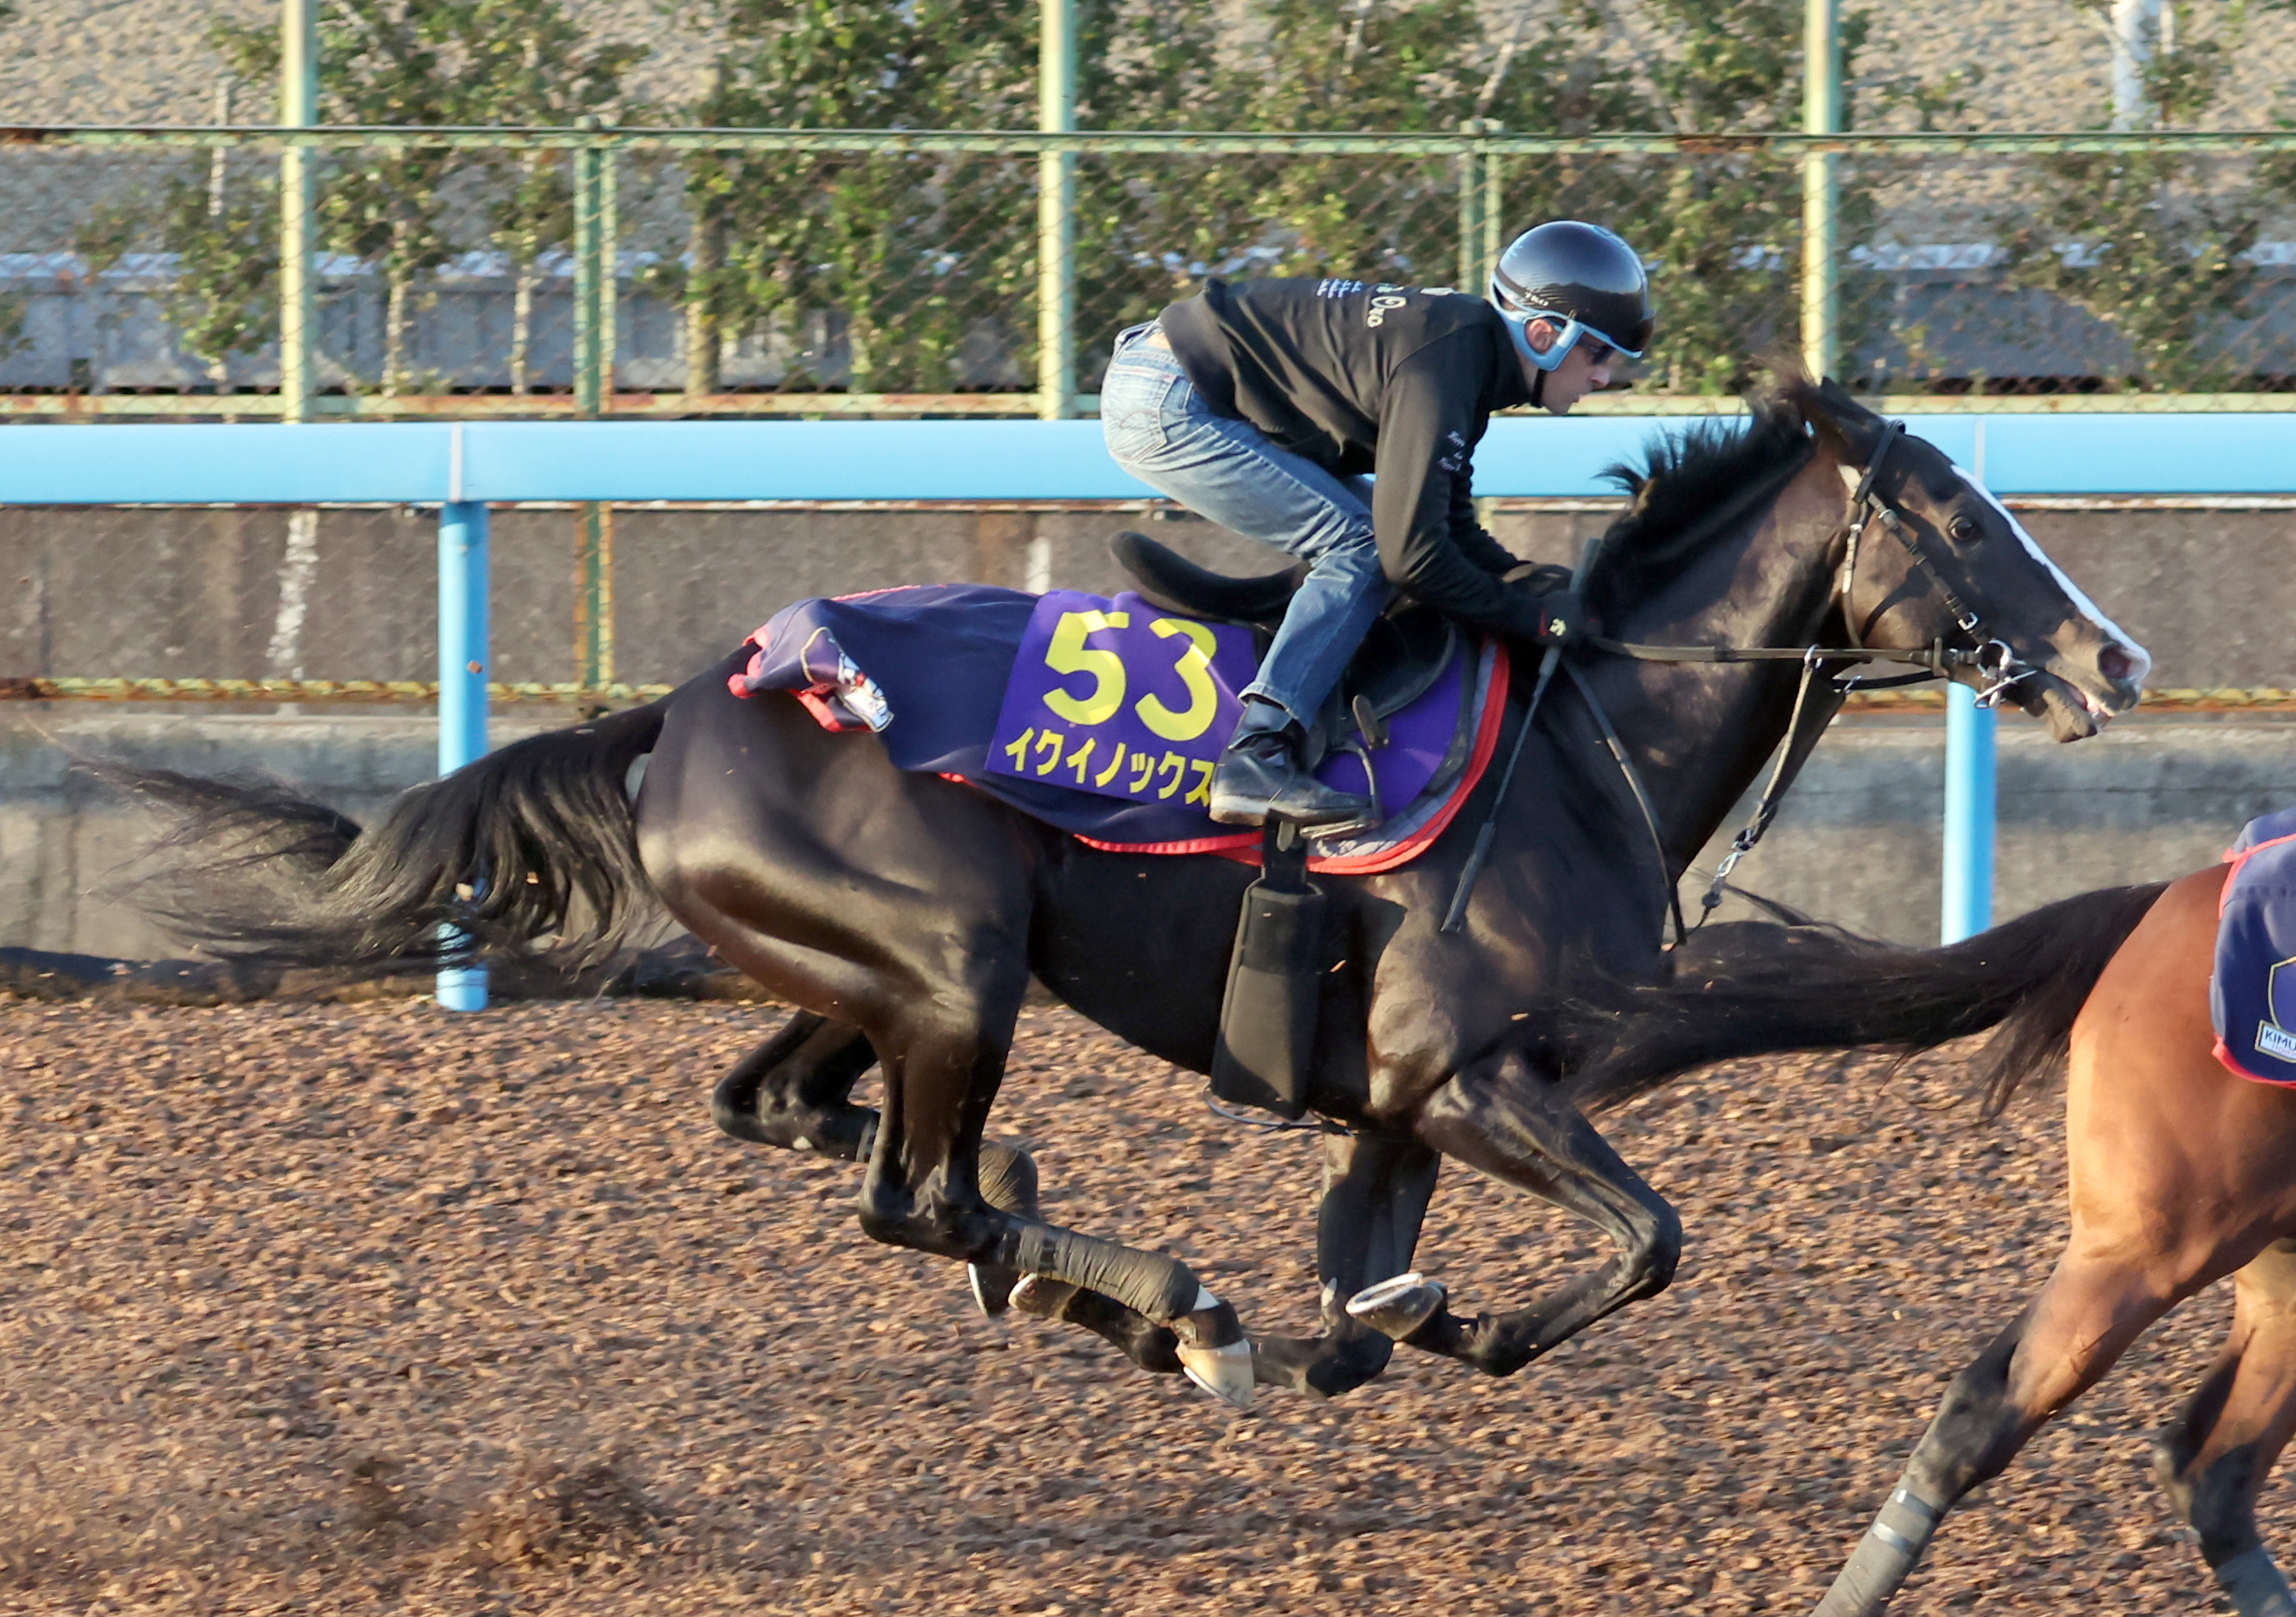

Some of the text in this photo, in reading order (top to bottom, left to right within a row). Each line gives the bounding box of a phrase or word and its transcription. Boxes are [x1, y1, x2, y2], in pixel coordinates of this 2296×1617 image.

[1043, 611, 1217, 741] 53
[1005, 727, 1215, 807] イクイノックス
